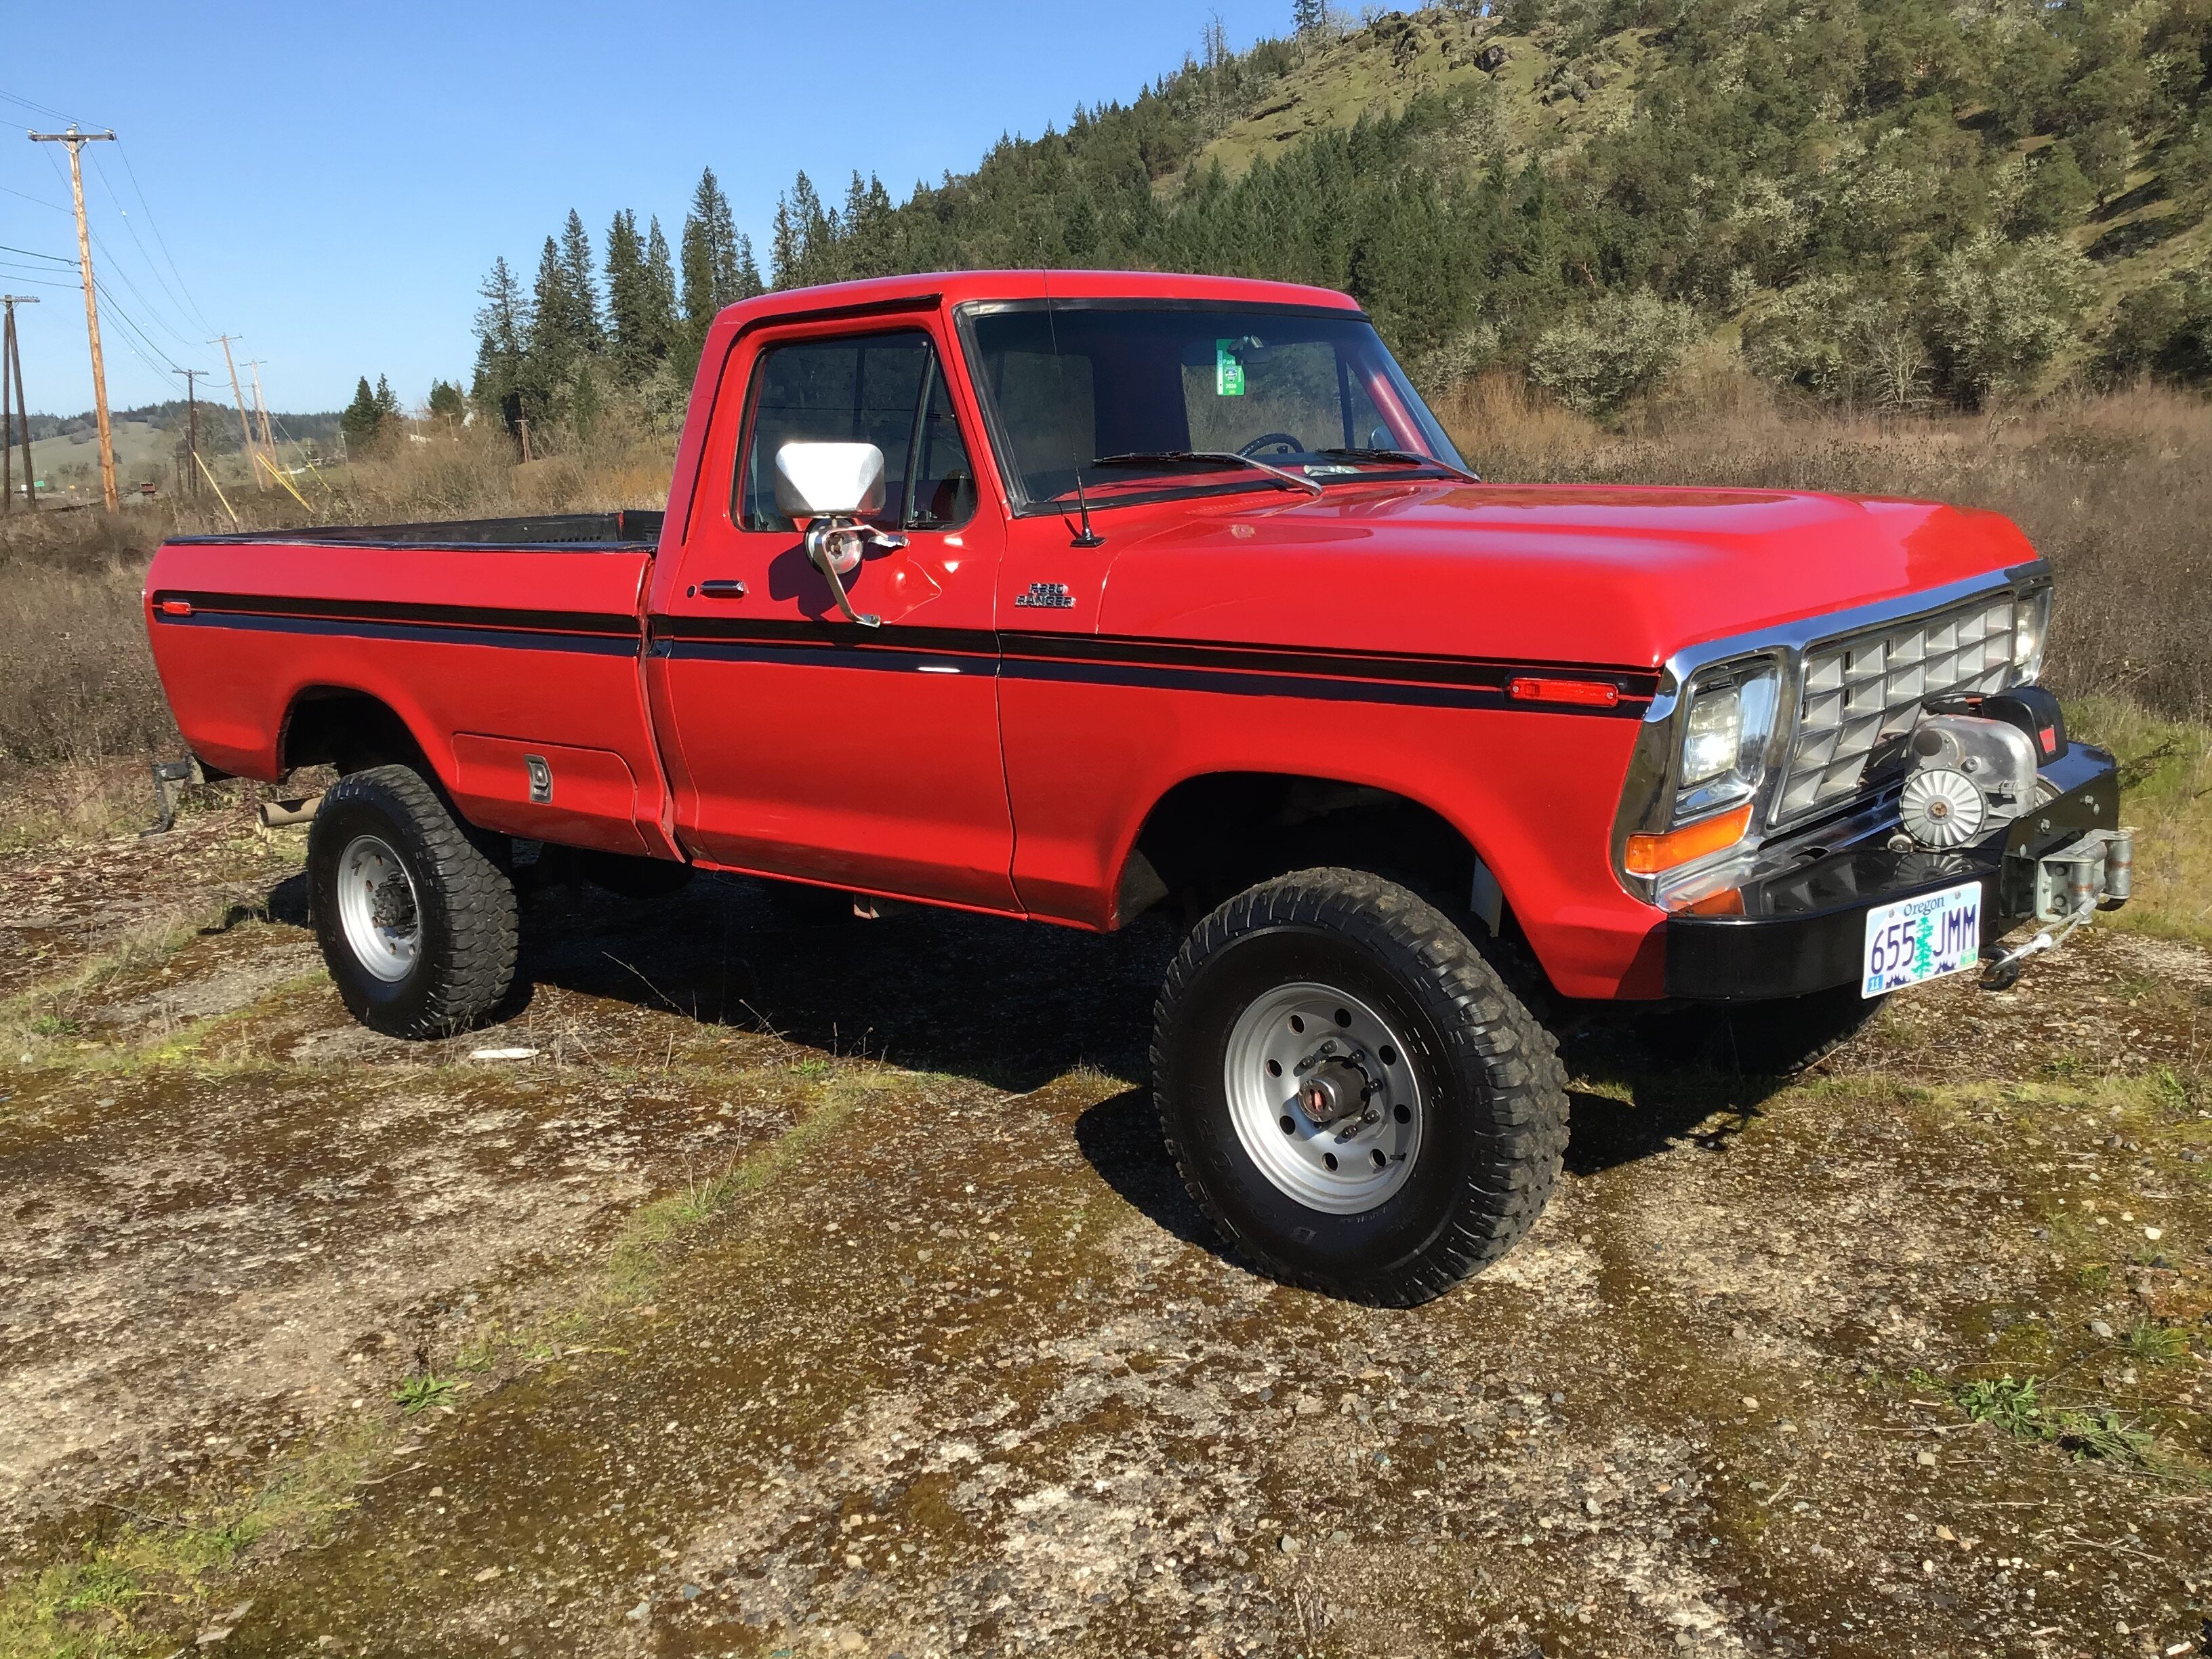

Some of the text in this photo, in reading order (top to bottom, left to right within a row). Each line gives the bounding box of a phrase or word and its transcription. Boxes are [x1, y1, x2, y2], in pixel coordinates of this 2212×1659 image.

[1015, 594, 1076, 609] RANGER
[1903, 897, 1945, 917] Oregon
[1870, 903, 1977, 975] 655 JMM
